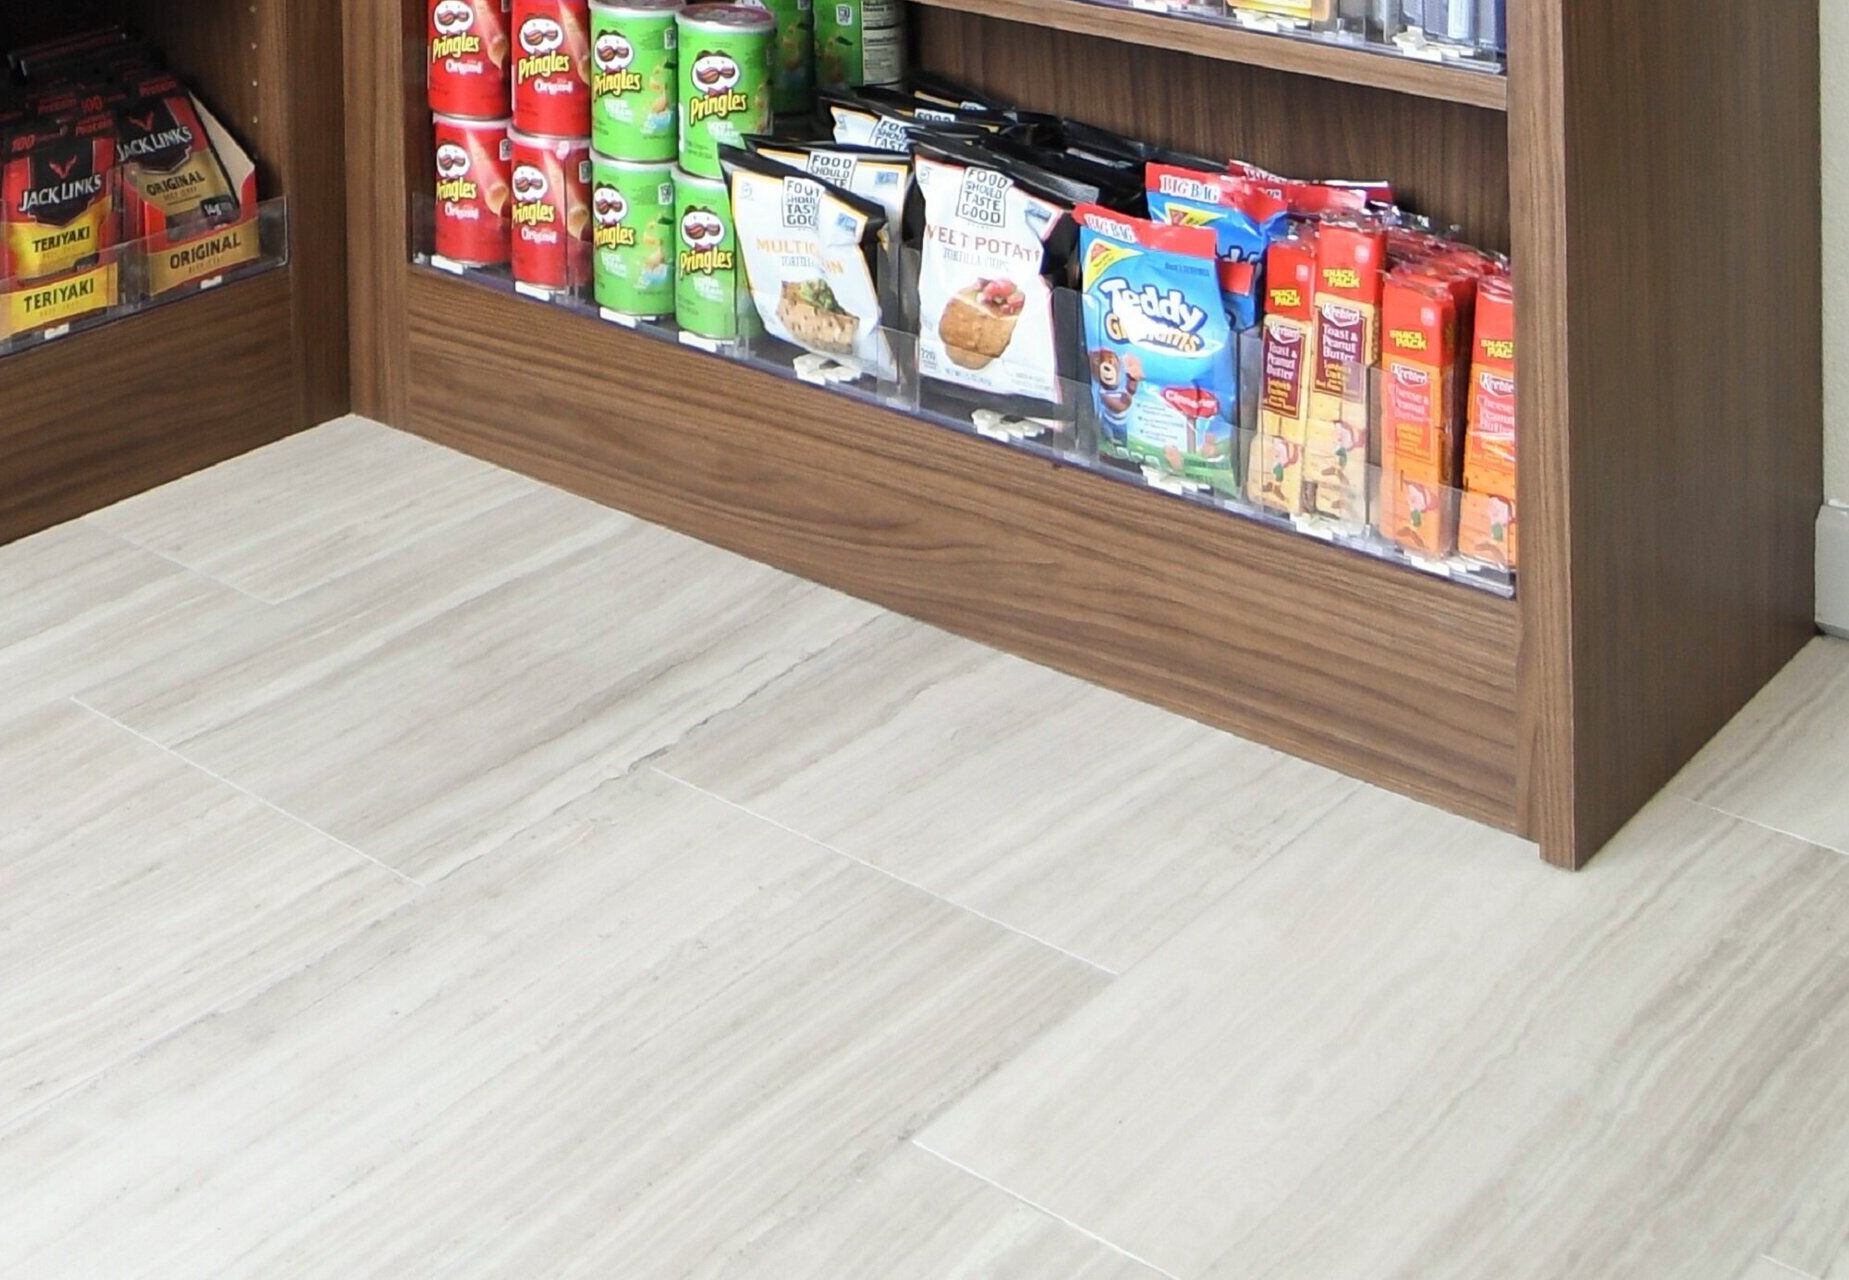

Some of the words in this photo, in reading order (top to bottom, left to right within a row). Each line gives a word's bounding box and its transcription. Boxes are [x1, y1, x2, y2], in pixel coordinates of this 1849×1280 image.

[432, 31, 480, 63] Pringles
[517, 50, 570, 85] Pringles
[593, 70, 642, 102] Pringles
[688, 90, 748, 126] Pringles
[812, 153, 852, 170] FOOD
[146, 170, 205, 196] ORIGINAL
[968, 166, 1008, 188] FOOD
[1161, 175, 1188, 196] BIG
[1190, 182, 1219, 202] BAG
[19, 188, 58, 212] JACK
[964, 192, 1002, 211] TASTE
[960, 204, 1002, 225] GOOD
[33, 226, 91, 253] TERIYAKI
[1086, 215, 1108, 233] BIG
[1109, 220, 1134, 243] BAG
[169, 233, 242, 270] ORIGINAL
[679, 248, 733, 277] Pringles
[1328, 275, 1360, 288] PACK
[23, 278, 95, 313] TERIYAKI
[1100, 278, 1207, 333] Teddy
[1323, 324, 1347, 340] Toast
[1349, 332, 1358, 342] &
[1323, 336, 1356, 354] Peanut
[1395, 336, 1426, 351] PACK
